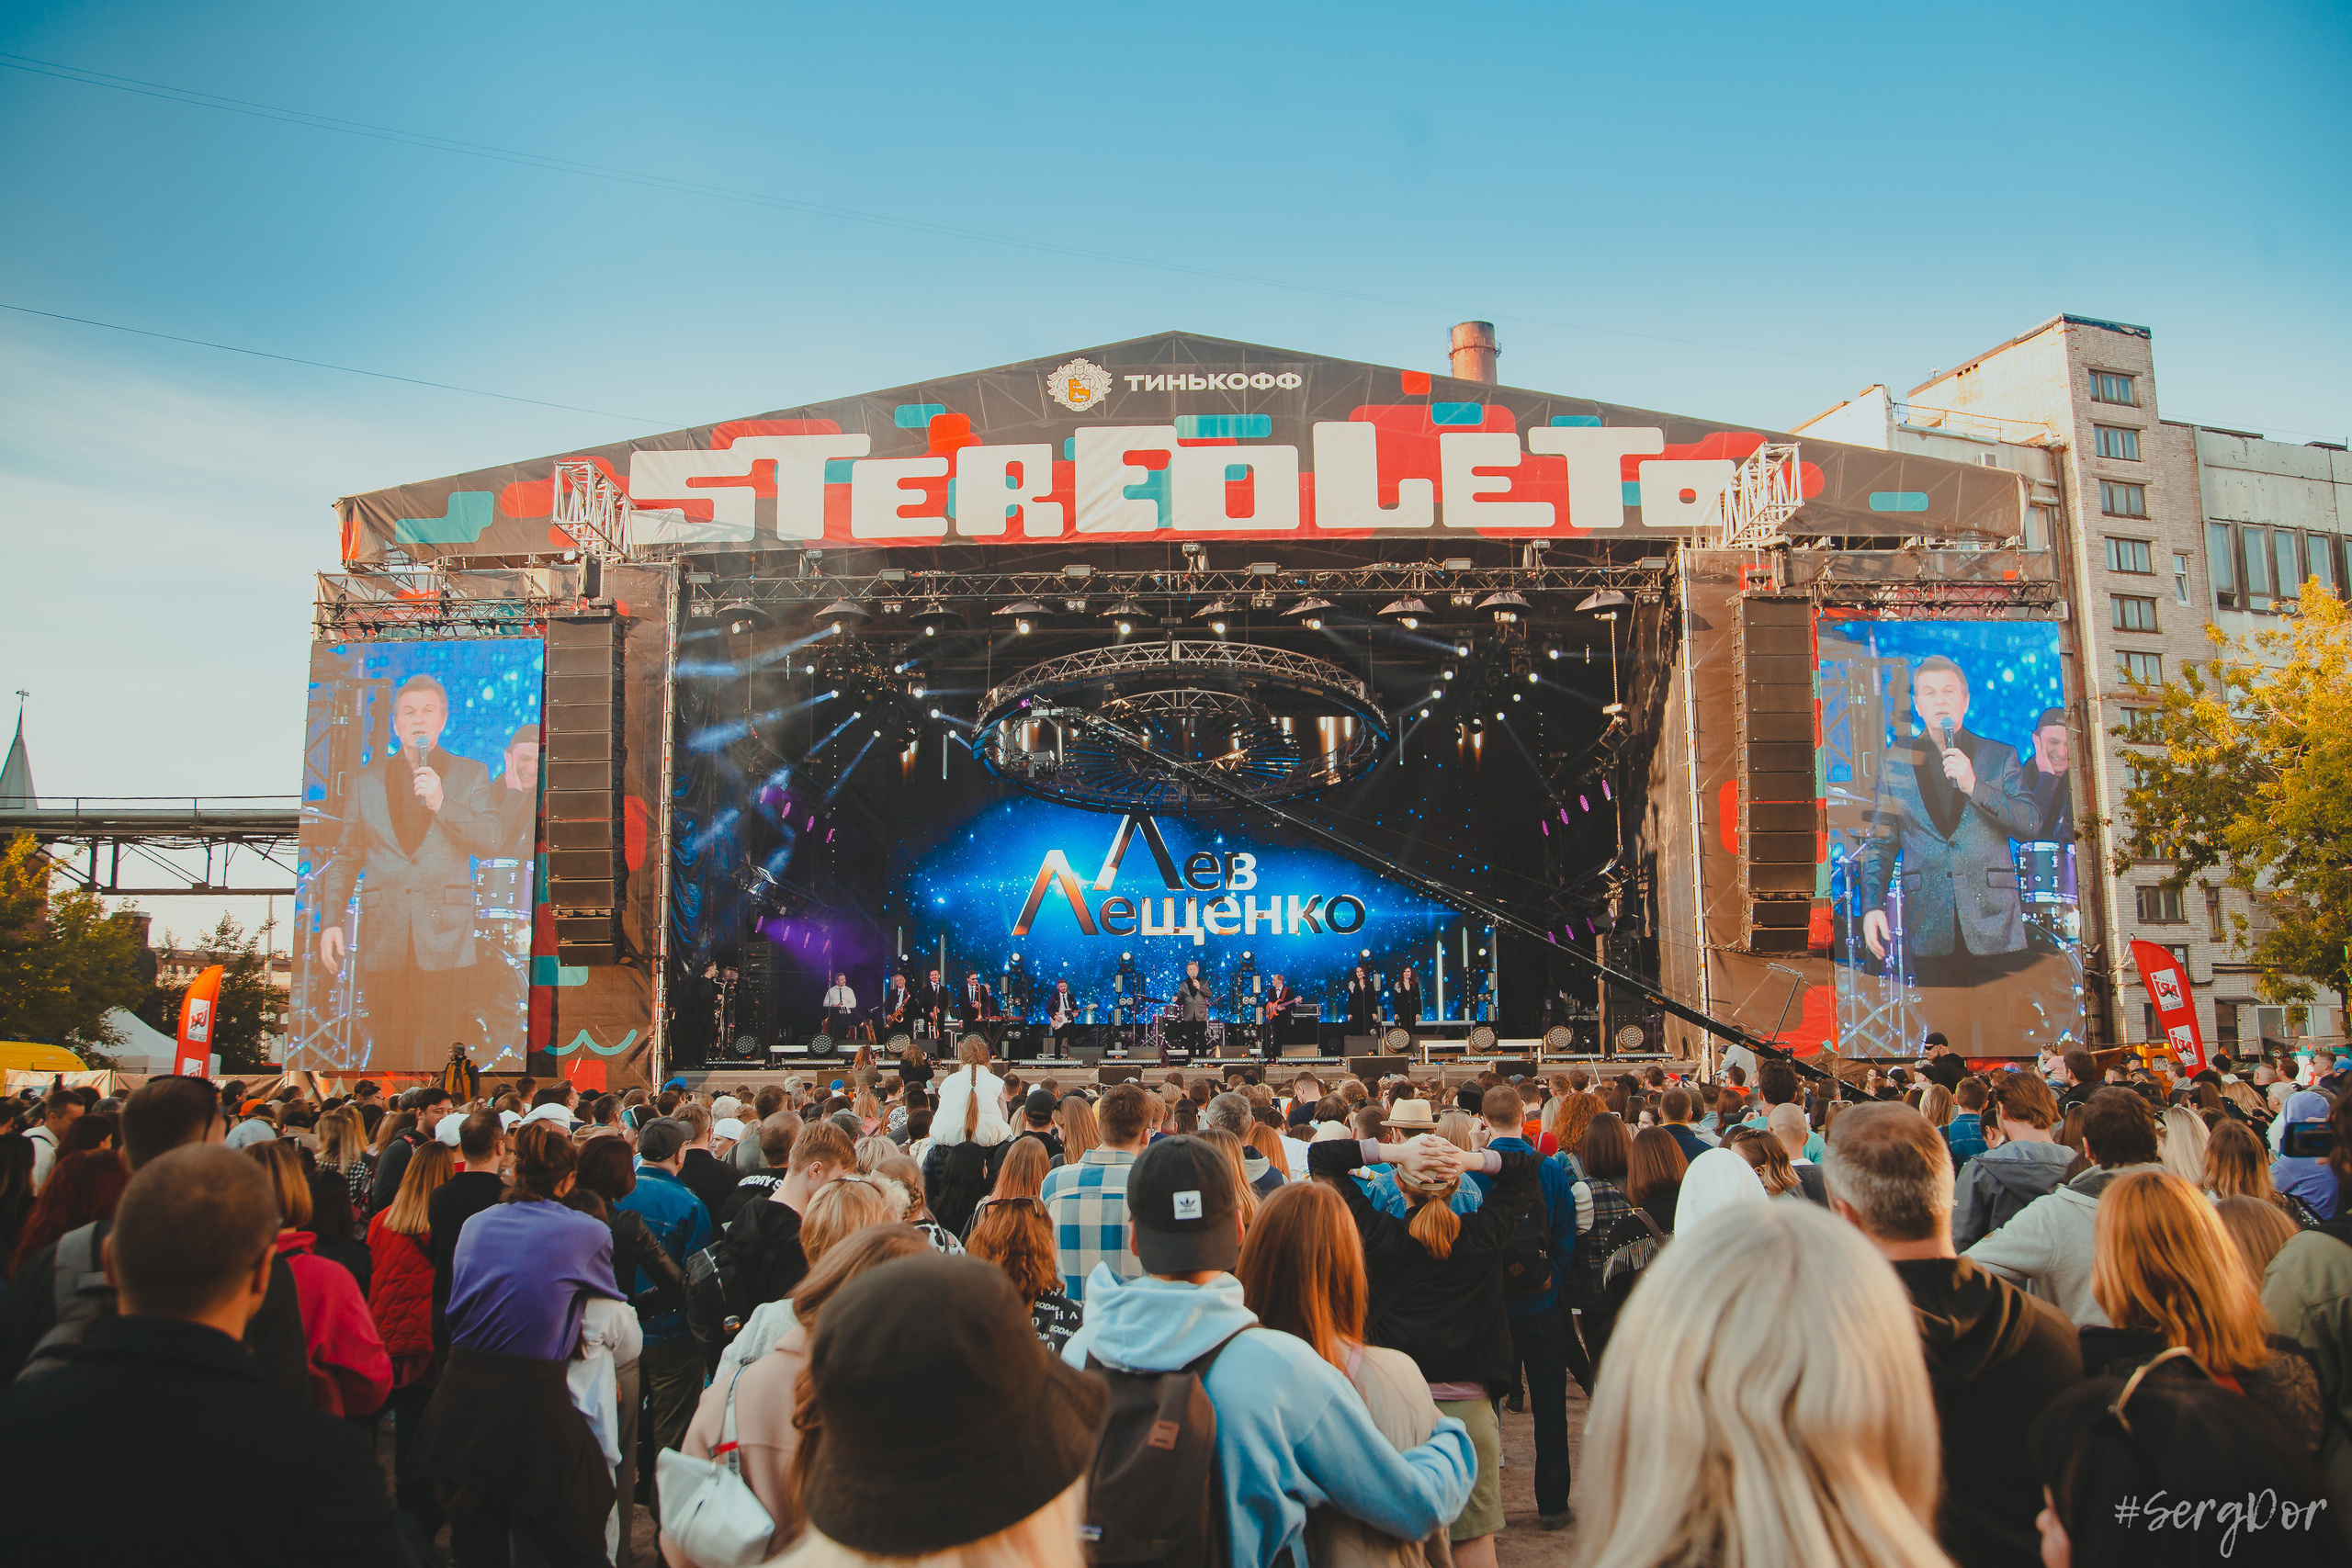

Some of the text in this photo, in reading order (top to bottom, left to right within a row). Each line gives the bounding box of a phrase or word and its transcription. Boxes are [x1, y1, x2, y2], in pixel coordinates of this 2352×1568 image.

[1124, 371, 1303, 392] ТИНЬКОФФ
[1092, 814, 1259, 892] Лев
[1012, 849, 1367, 946] Лещенко
